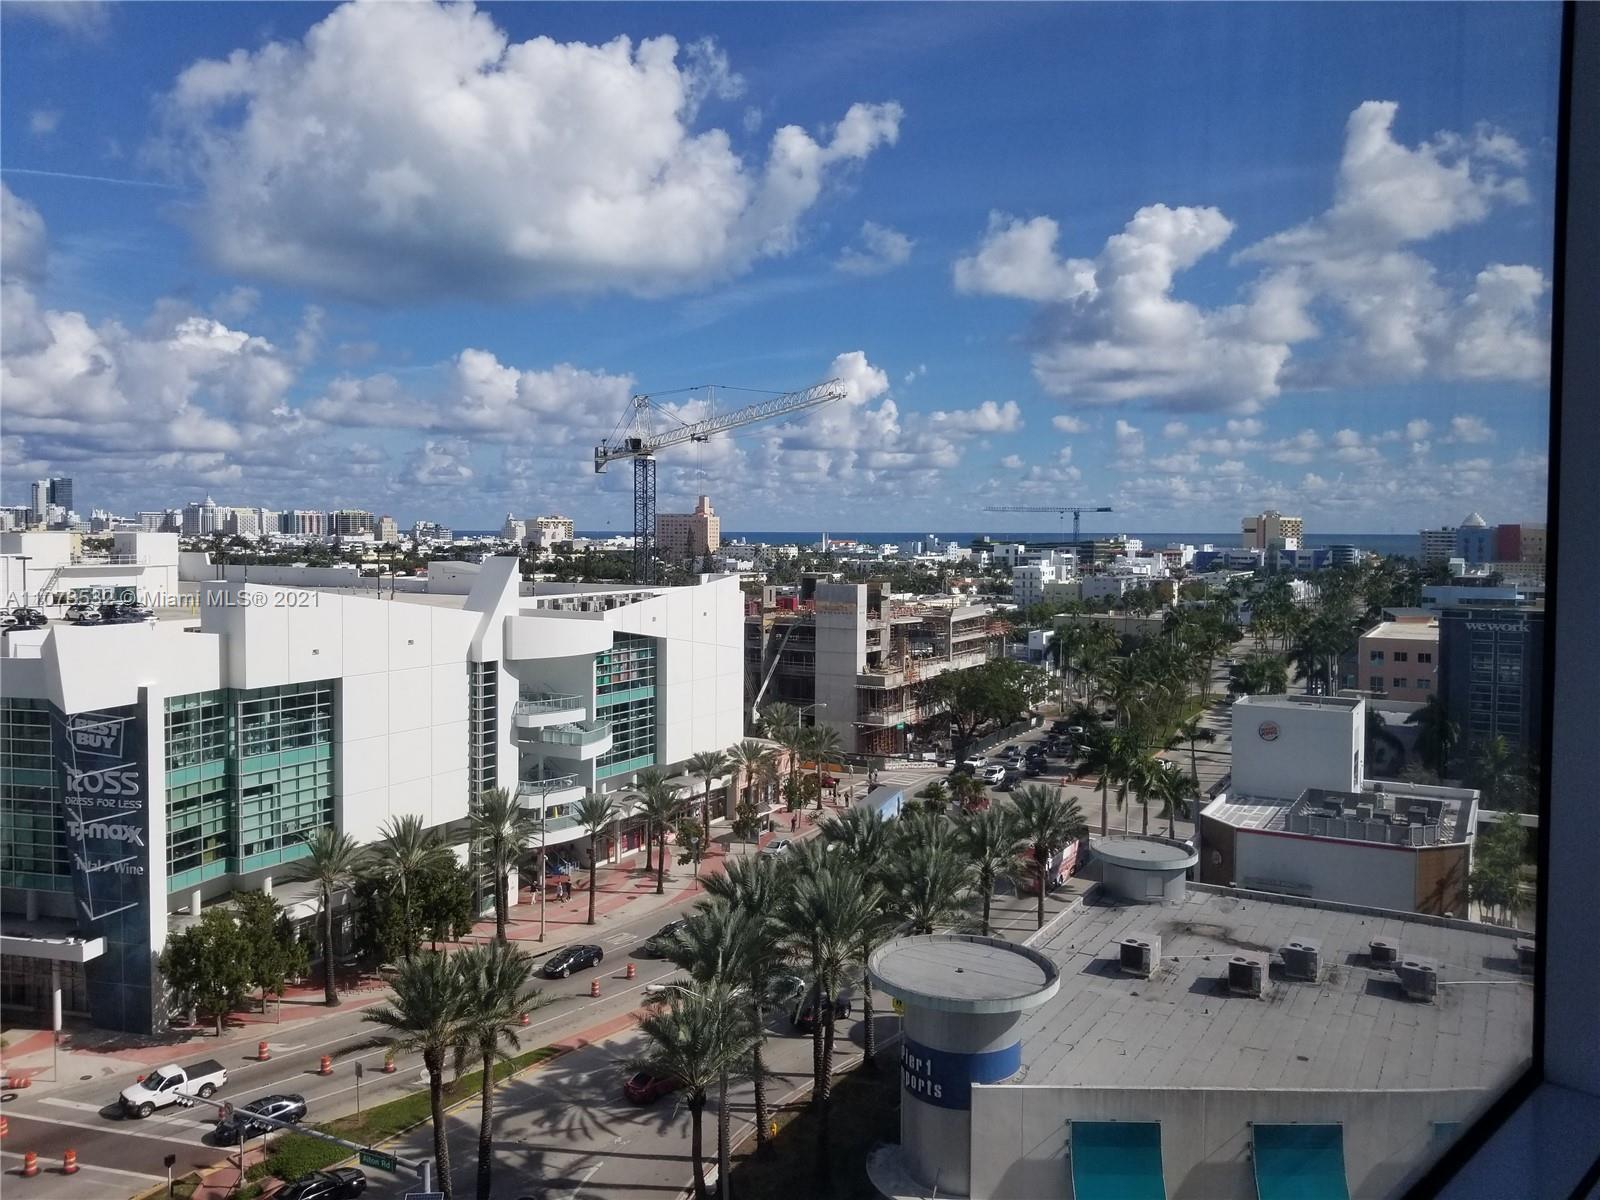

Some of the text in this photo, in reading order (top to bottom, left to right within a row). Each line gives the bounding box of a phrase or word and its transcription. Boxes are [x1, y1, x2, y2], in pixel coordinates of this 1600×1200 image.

[1465, 621, 1529, 632] wework
[75, 718, 120, 736] BEST
[76, 732, 116, 749] BUY
[66, 768, 139, 796] ROSS
[65, 796, 142, 810] DRESS FOR LESS
[114, 862, 144, 876] Wine
[925, 1059, 932, 1076] 1
